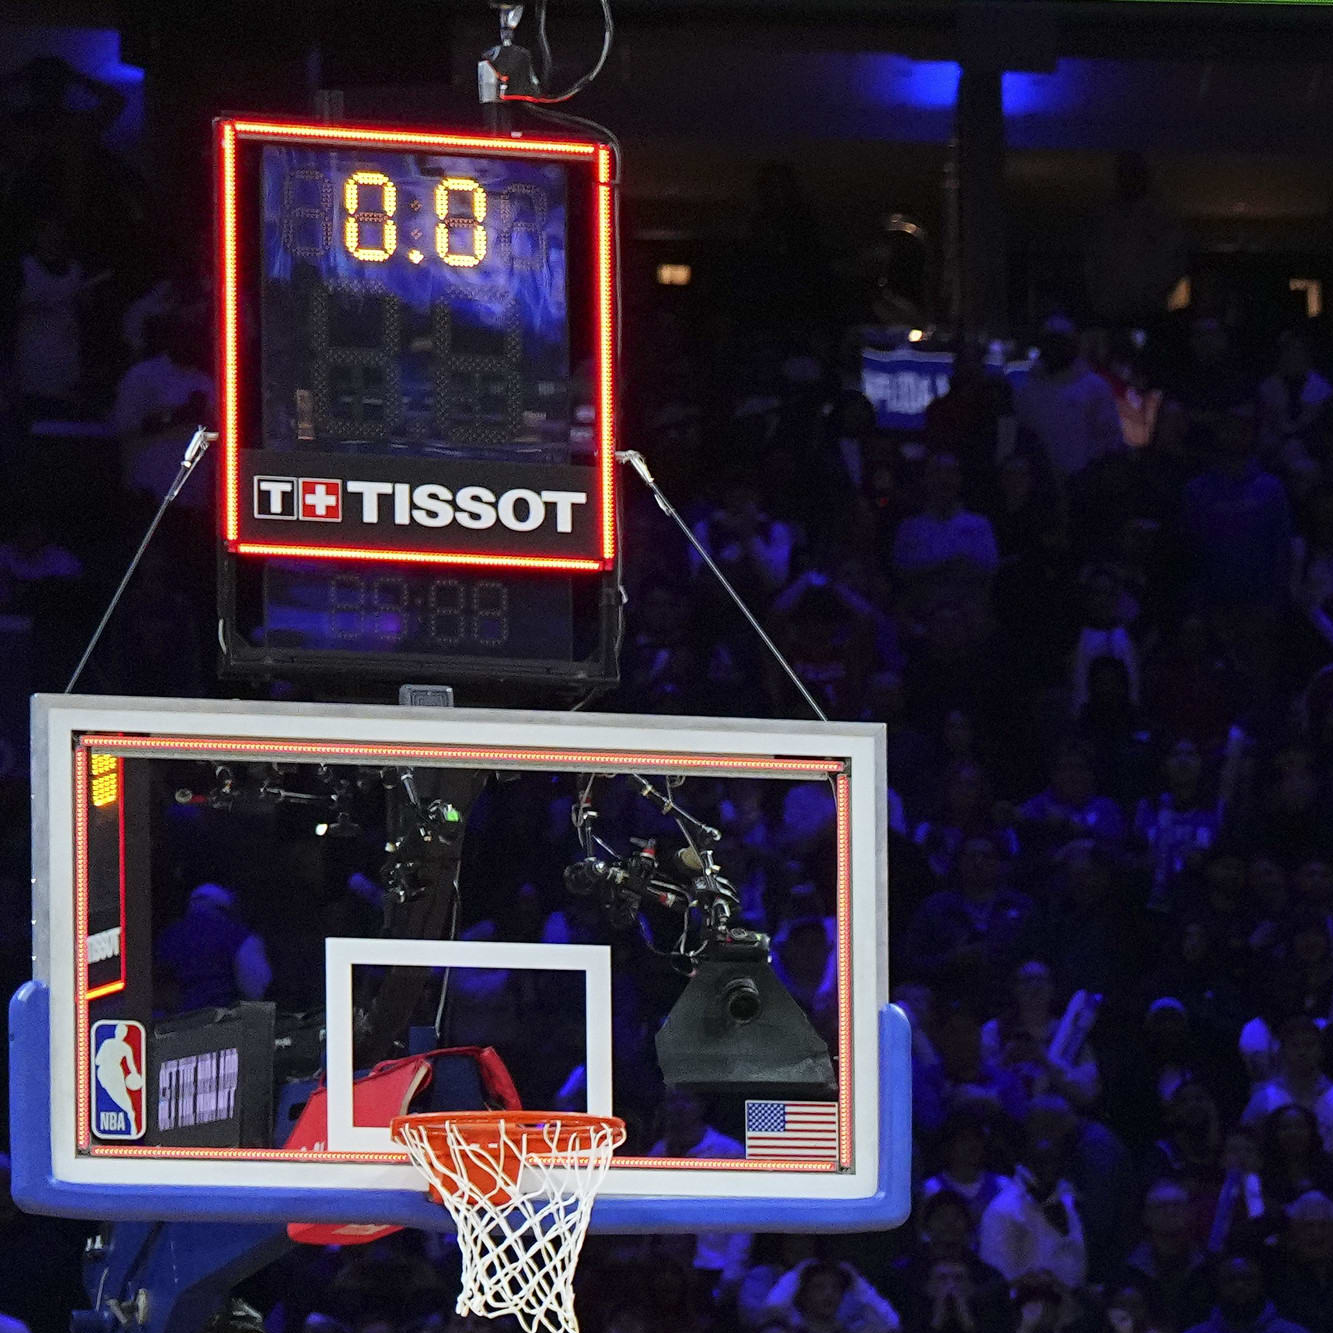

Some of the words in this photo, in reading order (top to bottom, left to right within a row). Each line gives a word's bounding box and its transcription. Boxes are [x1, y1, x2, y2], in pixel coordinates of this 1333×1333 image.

[344, 170, 487, 268] 0.0
[347, 480, 587, 534] TISSOT
[100, 1111, 126, 1131] NBA
